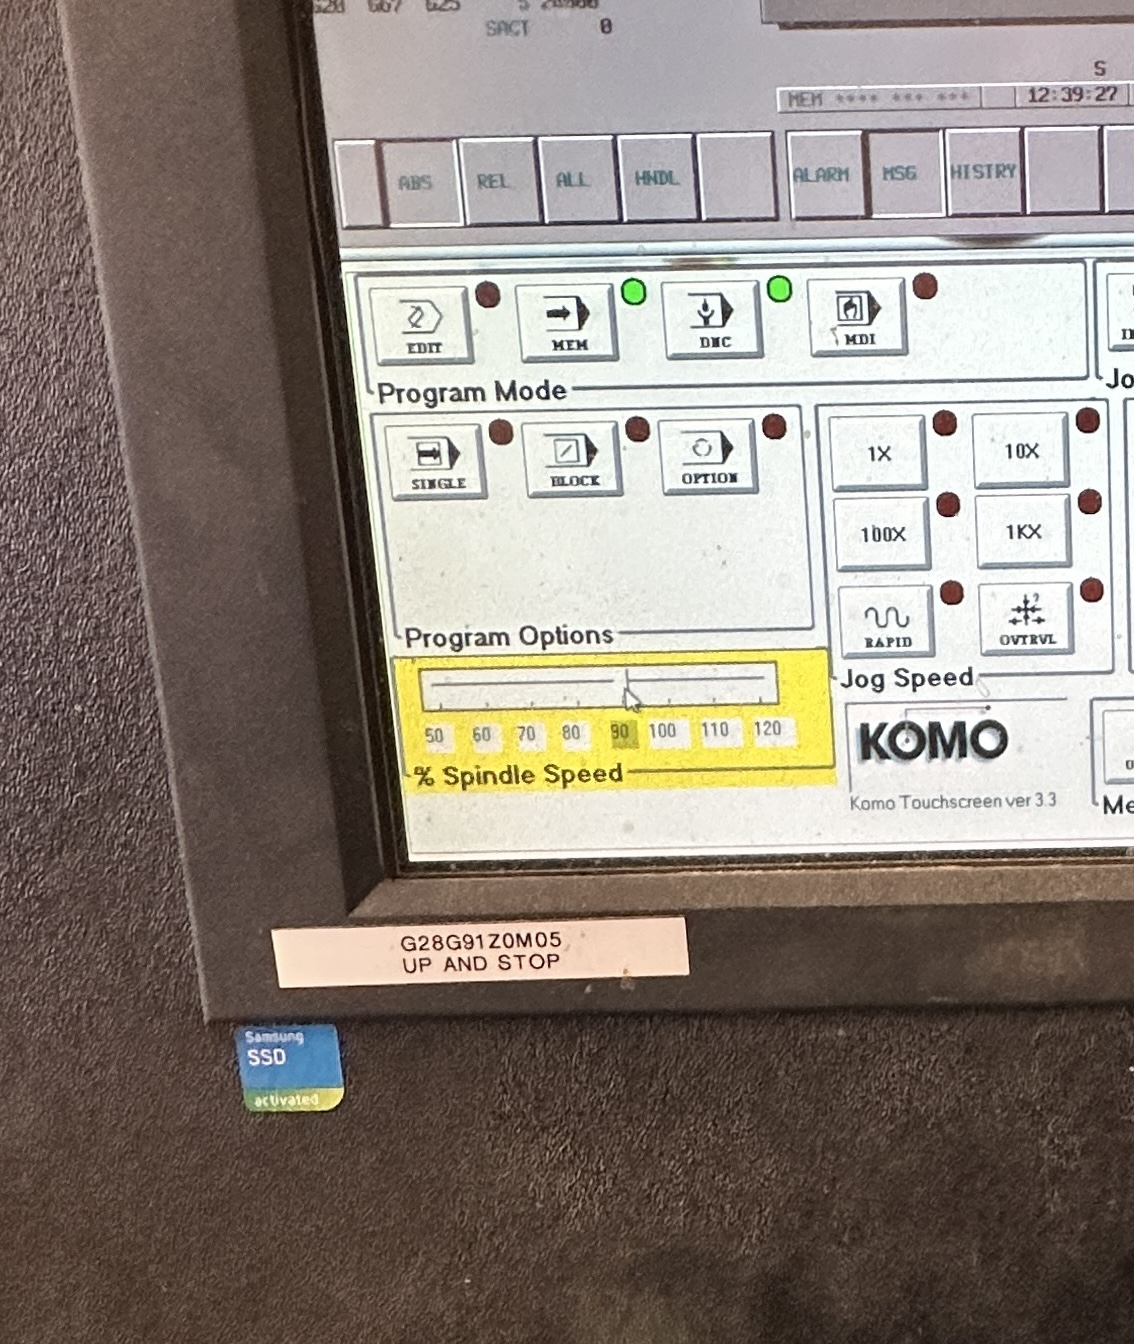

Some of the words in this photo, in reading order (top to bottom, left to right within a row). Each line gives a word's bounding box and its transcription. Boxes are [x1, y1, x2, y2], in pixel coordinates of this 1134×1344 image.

[788, 91, 824, 108] MEM
[1027, 85, 1118, 103] 12:39:27
[634, 169, 680, 187] HNDL
[792, 165, 850, 183] ALARM
[950, 162, 1017, 180] HISTRY
[397, 175, 433, 191] ABS
[477, 172, 511, 190] REL
[406, 342, 442, 355] EDIT
[551, 338, 589, 352] MEM
[845, 333, 876, 346] MDI
[378, 382, 487, 408] Program
[495, 379, 567, 402] Mode
[868, 444, 892, 462] 1X
[1005, 442, 1040, 460] 10X
[861, 526, 907, 543] 100X
[1006, 523, 1042, 541] 1KX
[404, 626, 511, 654] Program
[518, 623, 615, 648] Options
[864, 636, 913, 649] RAPID
[999, 633, 1057, 646] OVTRVL
[840, 669, 886, 693] Jog
[893, 666, 974, 693] Speed
[424, 728, 444, 745] 50
[472, 726, 491, 743] 60
[517, 726, 536, 742] 70
[562, 724, 581, 741] 80
[610, 723, 630, 740] 90
[649, 723, 677, 739] 100
[701, 721, 729, 738] 110
[754, 720, 782, 737] 120
[859, 719, 1009, 761] KOMO
[412, 767, 435, 787] %
[443, 765, 536, 791] Spindle
[544, 762, 624, 789] Speed
[850, 796, 896, 811] Komo
[898, 794, 1003, 811] Touchscreen
[1005, 796, 1031, 808] ver
[1034, 792, 1058, 808] 3.3
[400, 931, 563, 953] G28G91Z0M05
[403, 956, 432, 975] UP
[444, 955, 489, 973] AND
[497, 953, 562, 972] STOP
[245, 1030, 305, 1046] Samsung
[246, 1048, 287, 1067] SSD
[254, 1093, 320, 1108] activated
